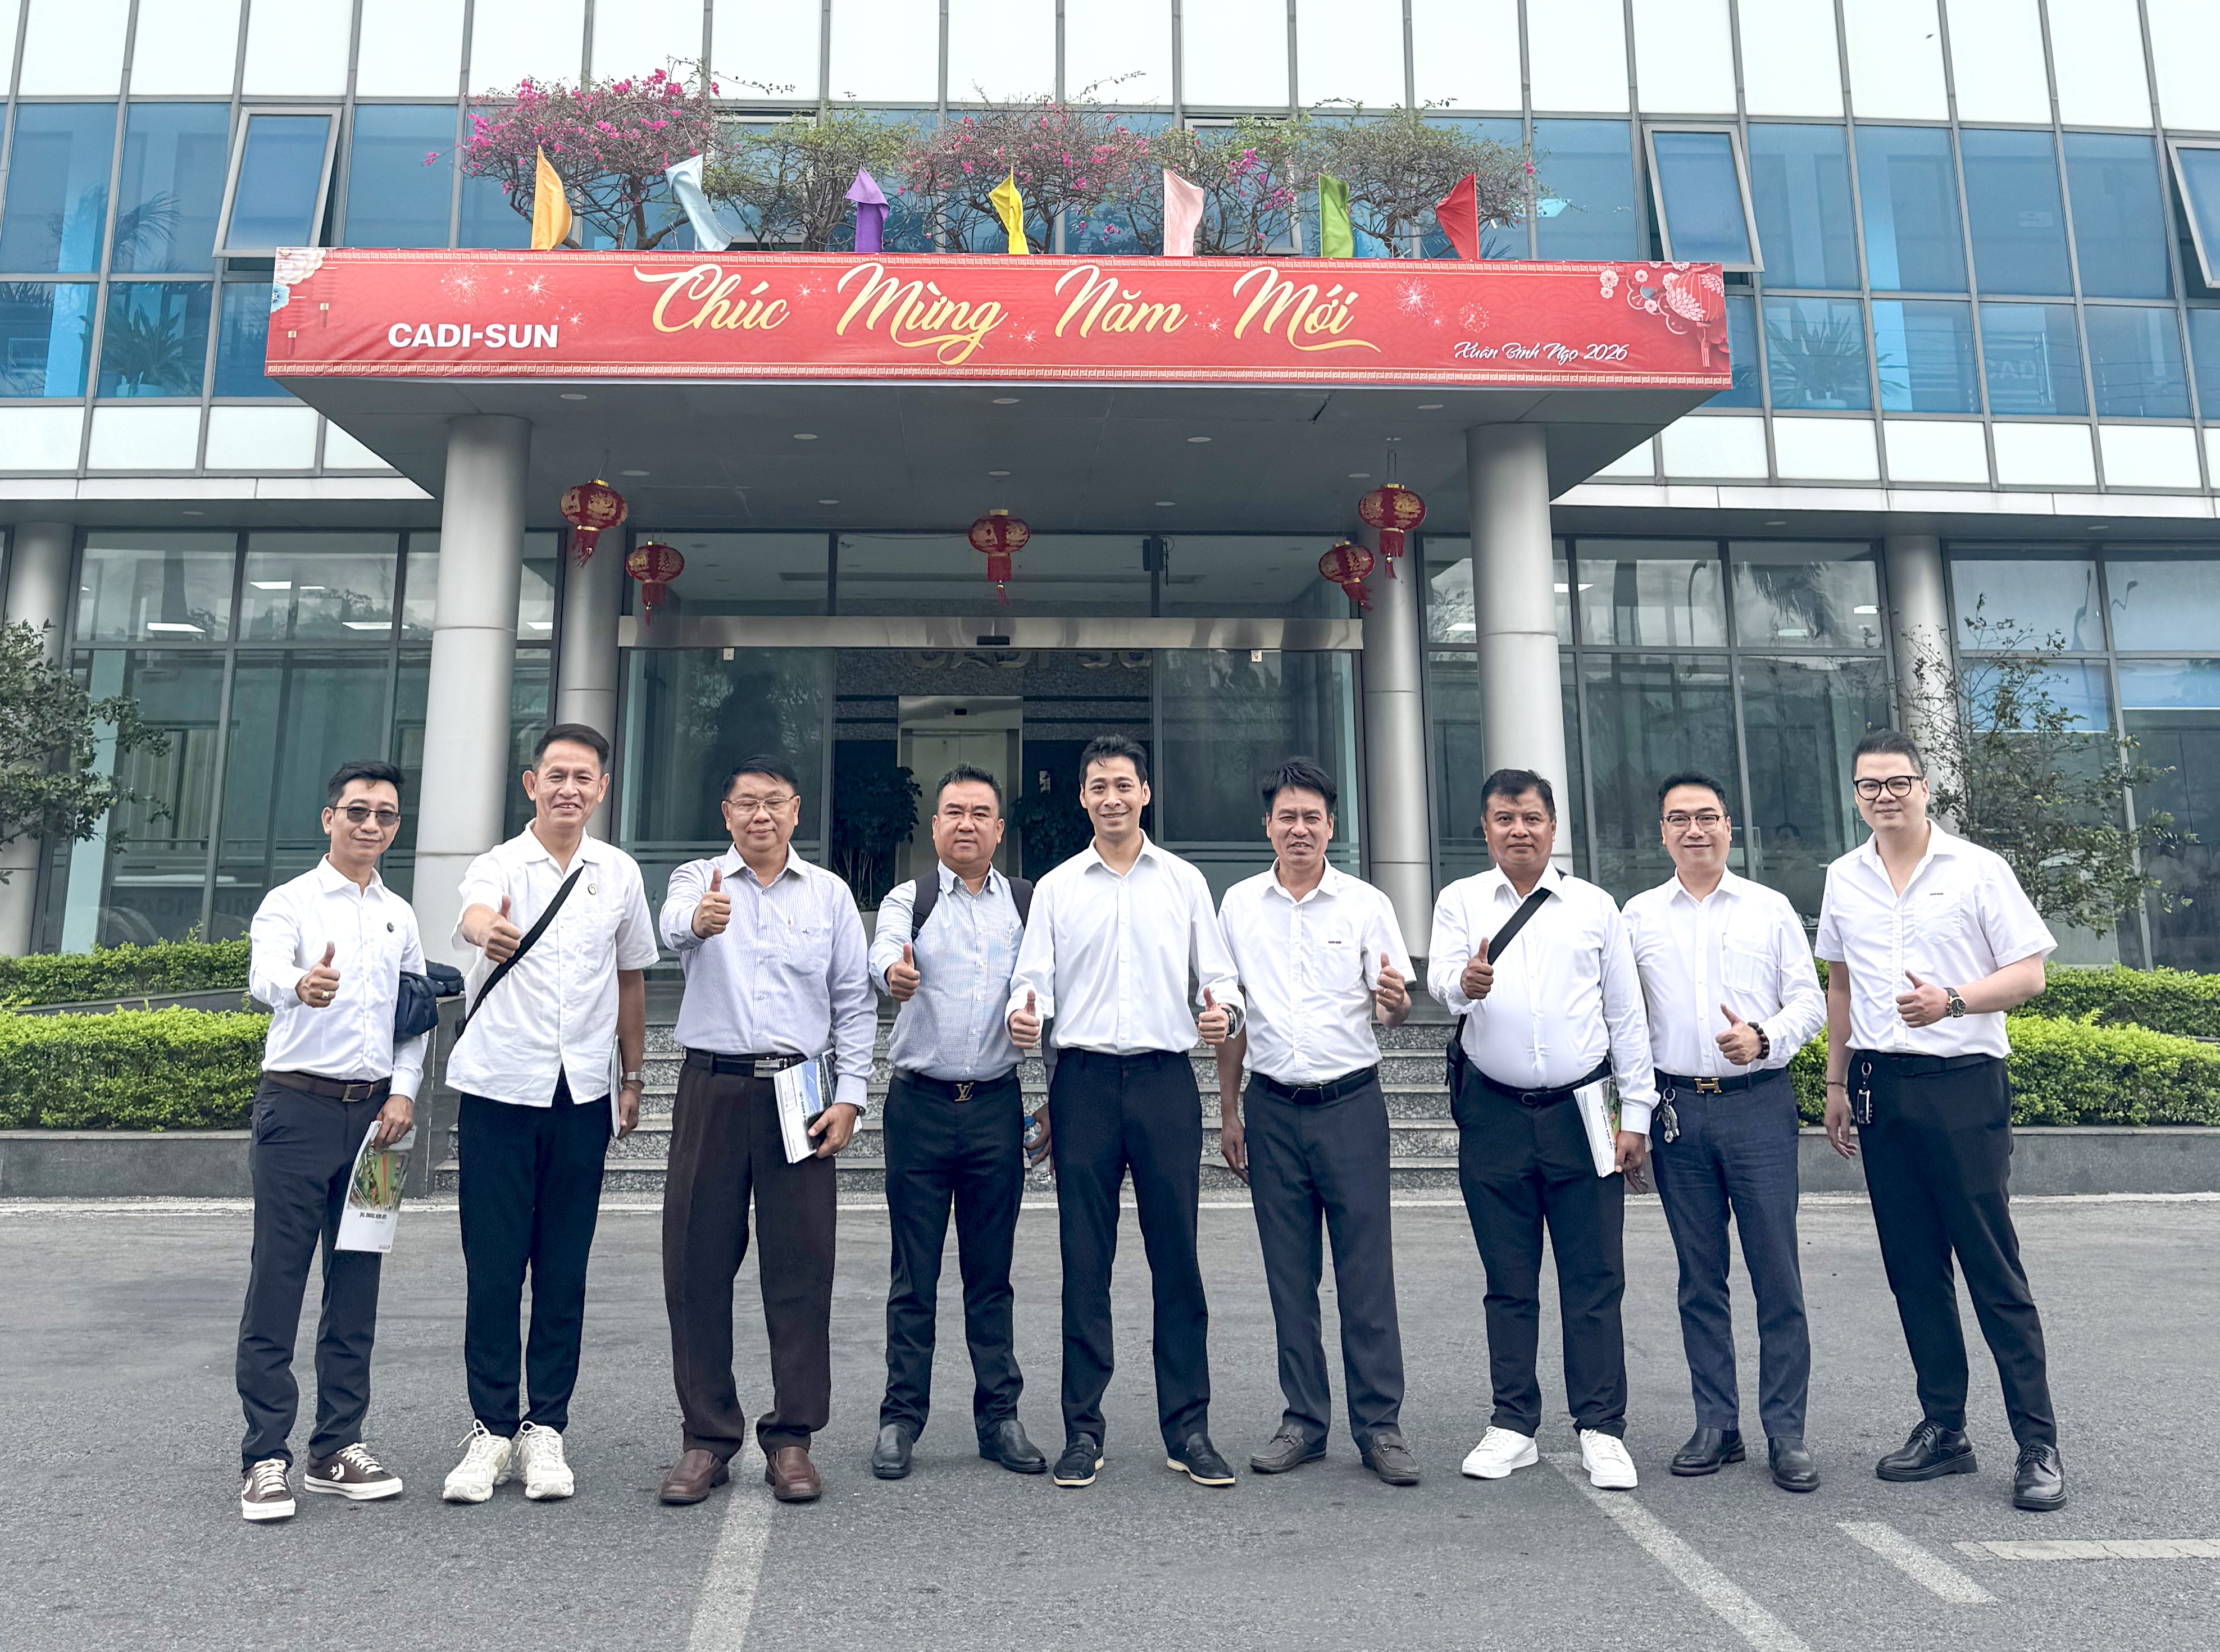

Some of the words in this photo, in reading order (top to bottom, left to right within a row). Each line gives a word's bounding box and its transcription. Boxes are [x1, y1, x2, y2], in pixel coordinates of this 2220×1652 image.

[634, 263, 790, 333] Chúc
[836, 262, 1009, 366] Mừng
[1054, 264, 1189, 339] Năm
[1232, 266, 1381, 353] Mới
[388, 322, 558, 349] CADI-SUN
[1454, 341, 1499, 359] Xuân
[1501, 342, 1540, 359] Bính
[1543, 343, 1579, 366] Ngọ
[1583, 343, 1630, 361] 2026
